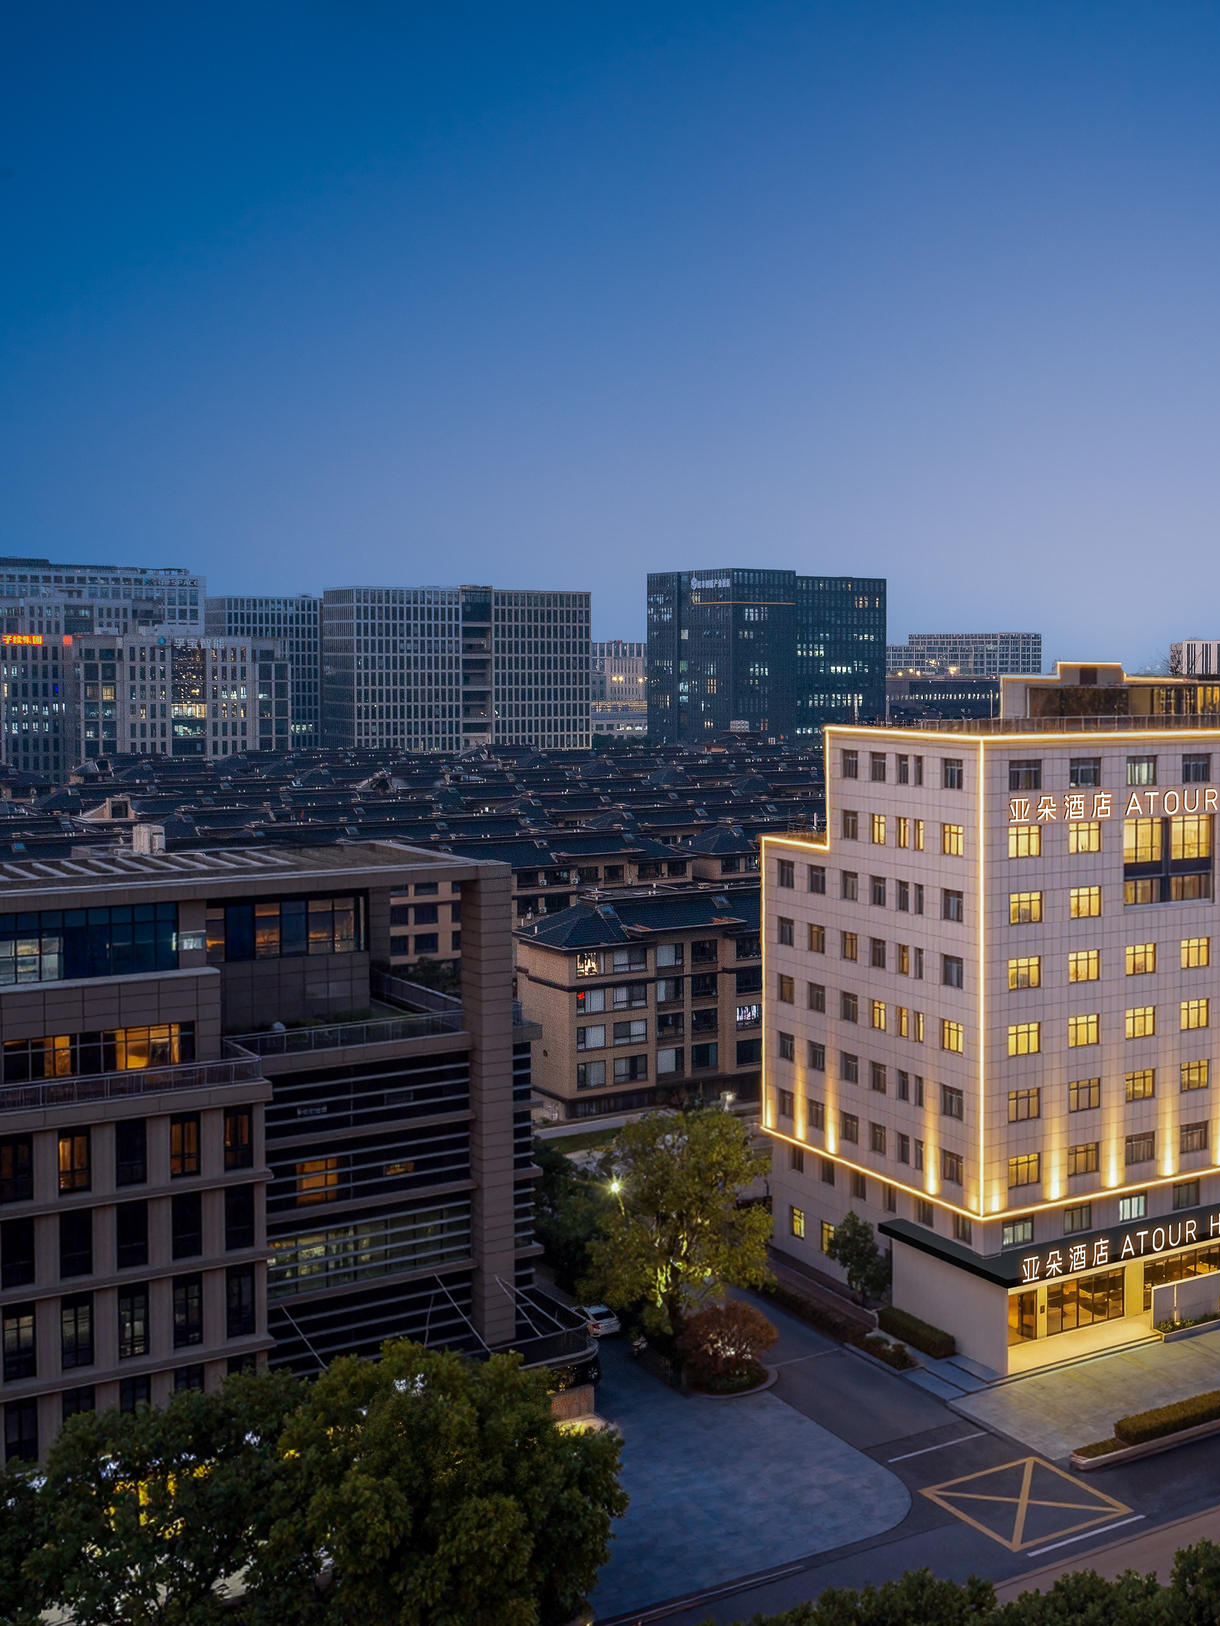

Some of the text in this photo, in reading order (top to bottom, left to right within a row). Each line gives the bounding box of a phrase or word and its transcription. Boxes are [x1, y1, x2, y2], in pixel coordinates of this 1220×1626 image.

[1009, 791, 1112, 823] 亚朵酒店
[1125, 788, 1218, 816] ATOUR
[1121, 1219, 1197, 1259] ATOUR
[1022, 1238, 1110, 1283] 亚朵酒店
